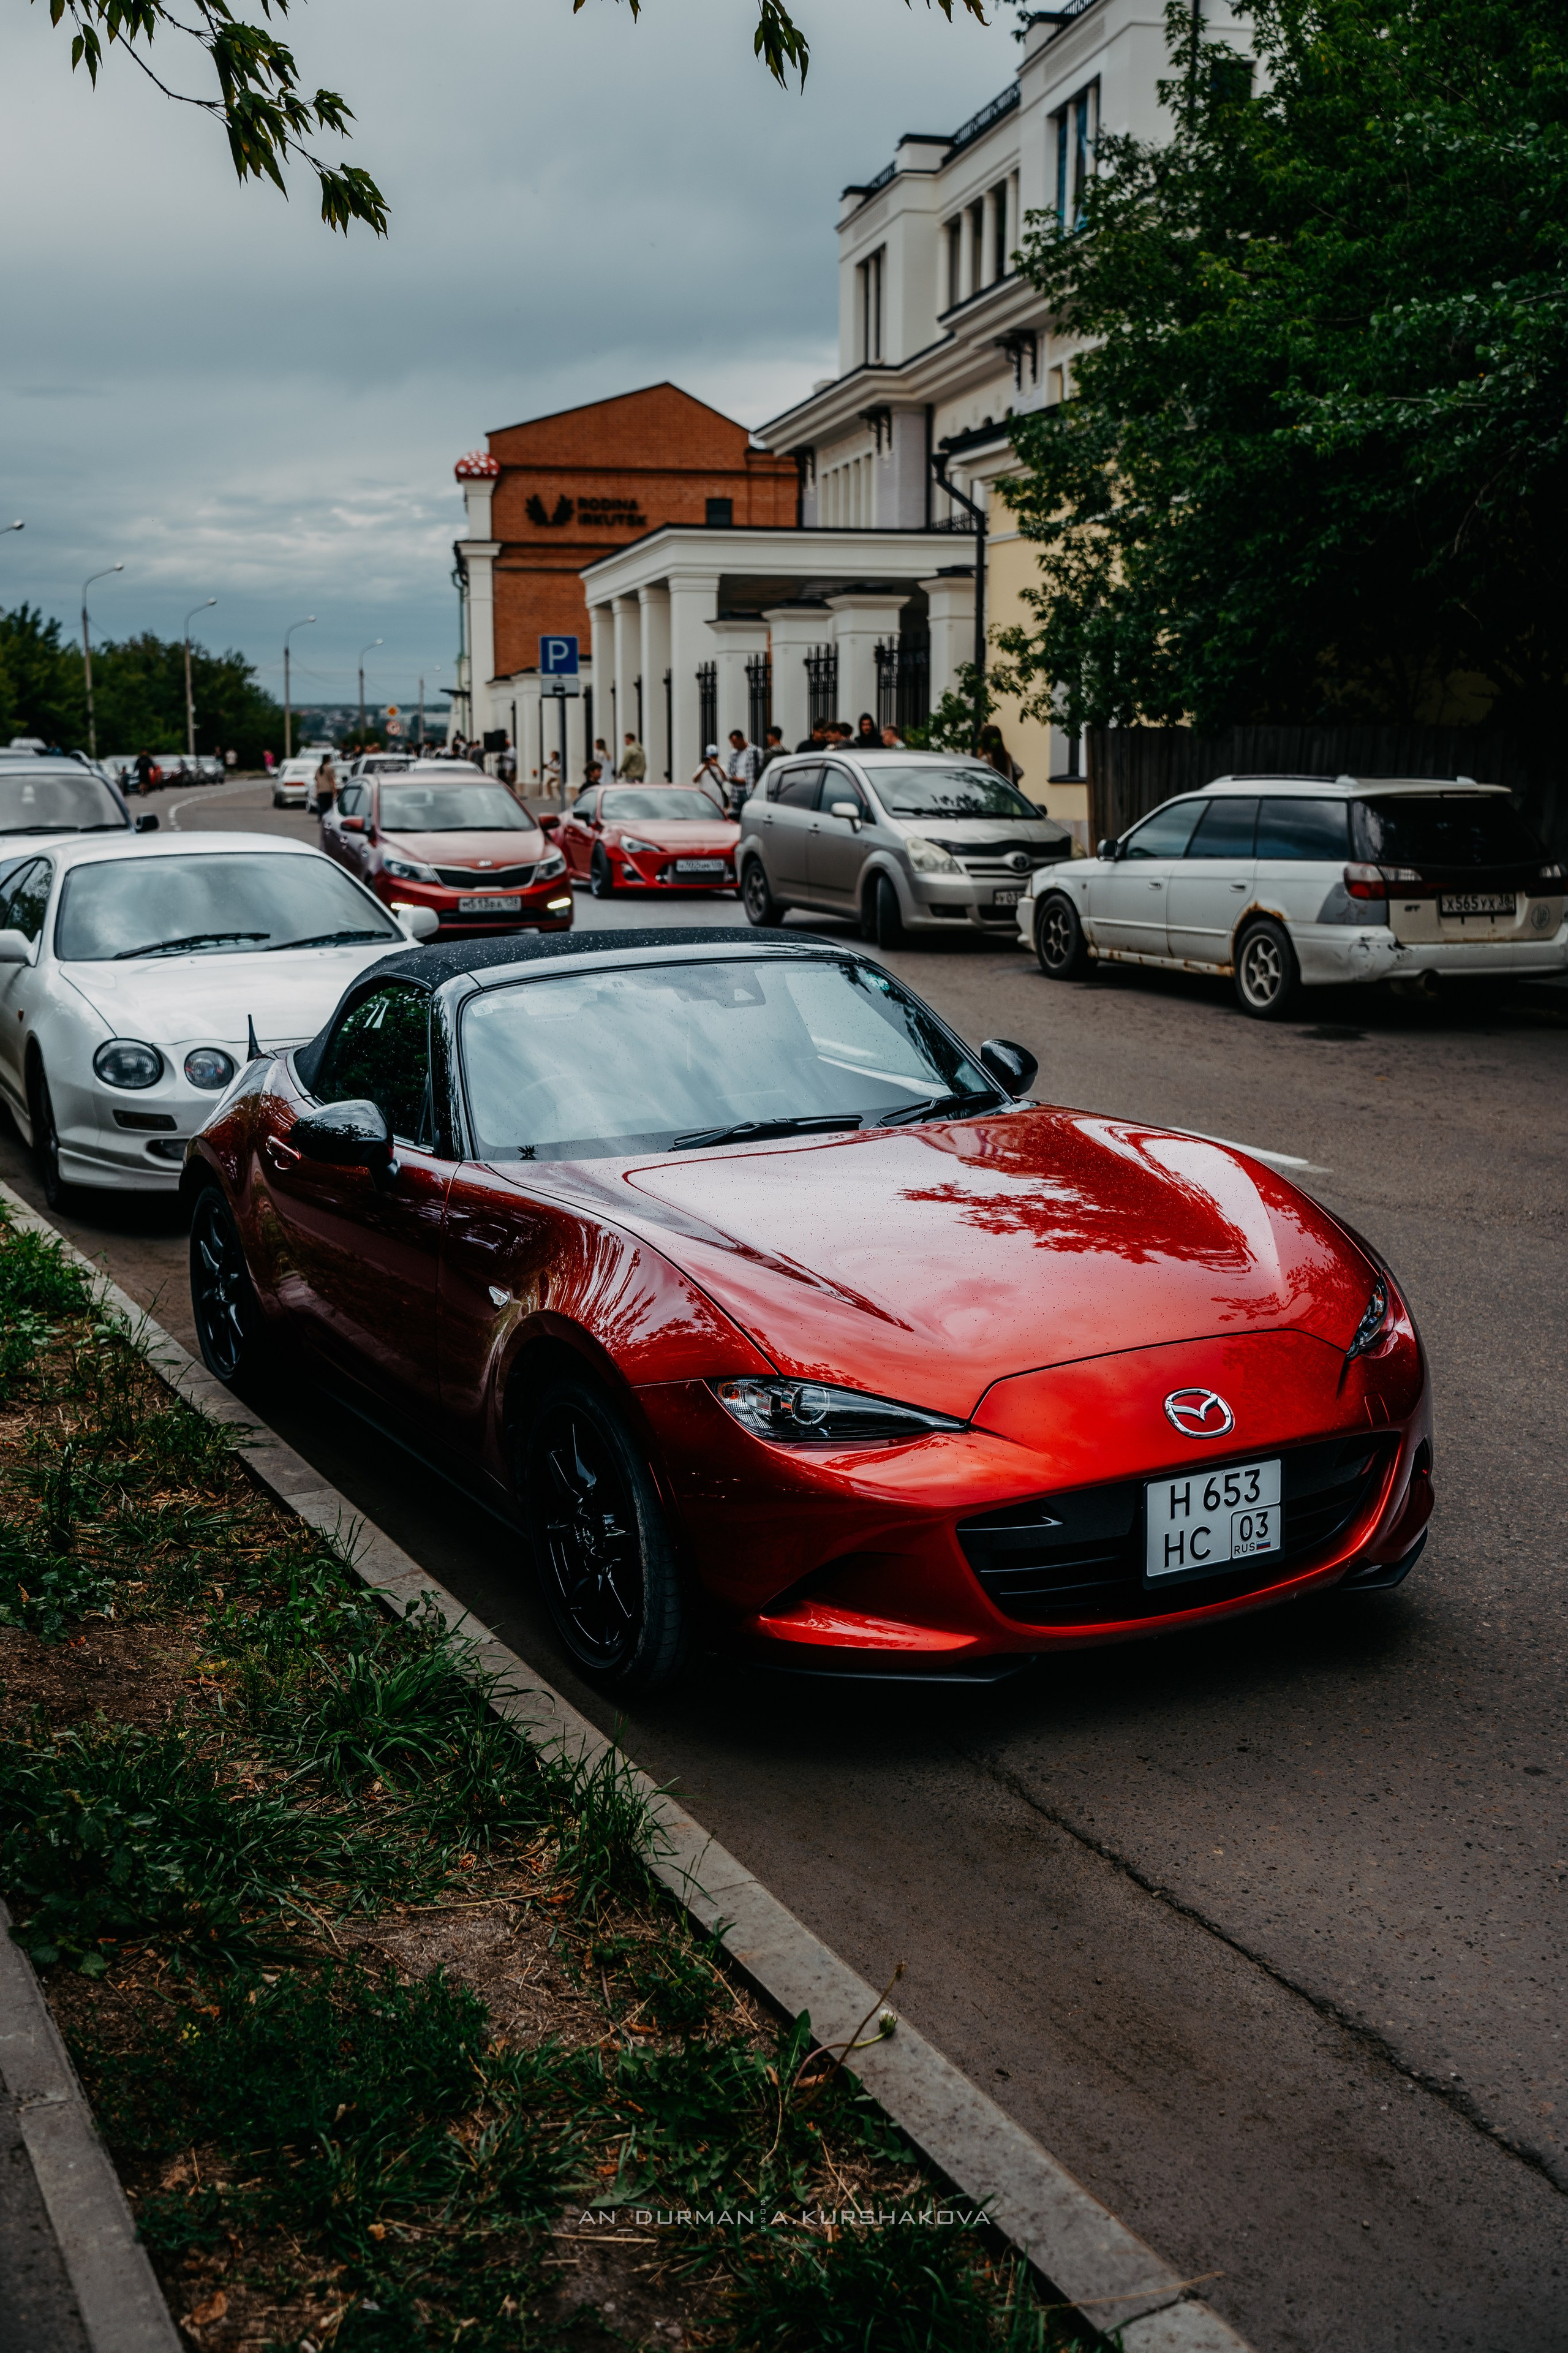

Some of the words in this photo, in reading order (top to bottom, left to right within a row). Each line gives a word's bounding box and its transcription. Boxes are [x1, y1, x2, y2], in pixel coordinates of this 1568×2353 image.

[578, 496, 638, 510] RODINA
[578, 513, 647, 526] IRKUTSK
[549, 641, 568, 670] P
[1203, 1468, 1261, 1511] 653
[1240, 1511, 1268, 1541] 03
[1234, 1542, 1255, 1555] RUS
